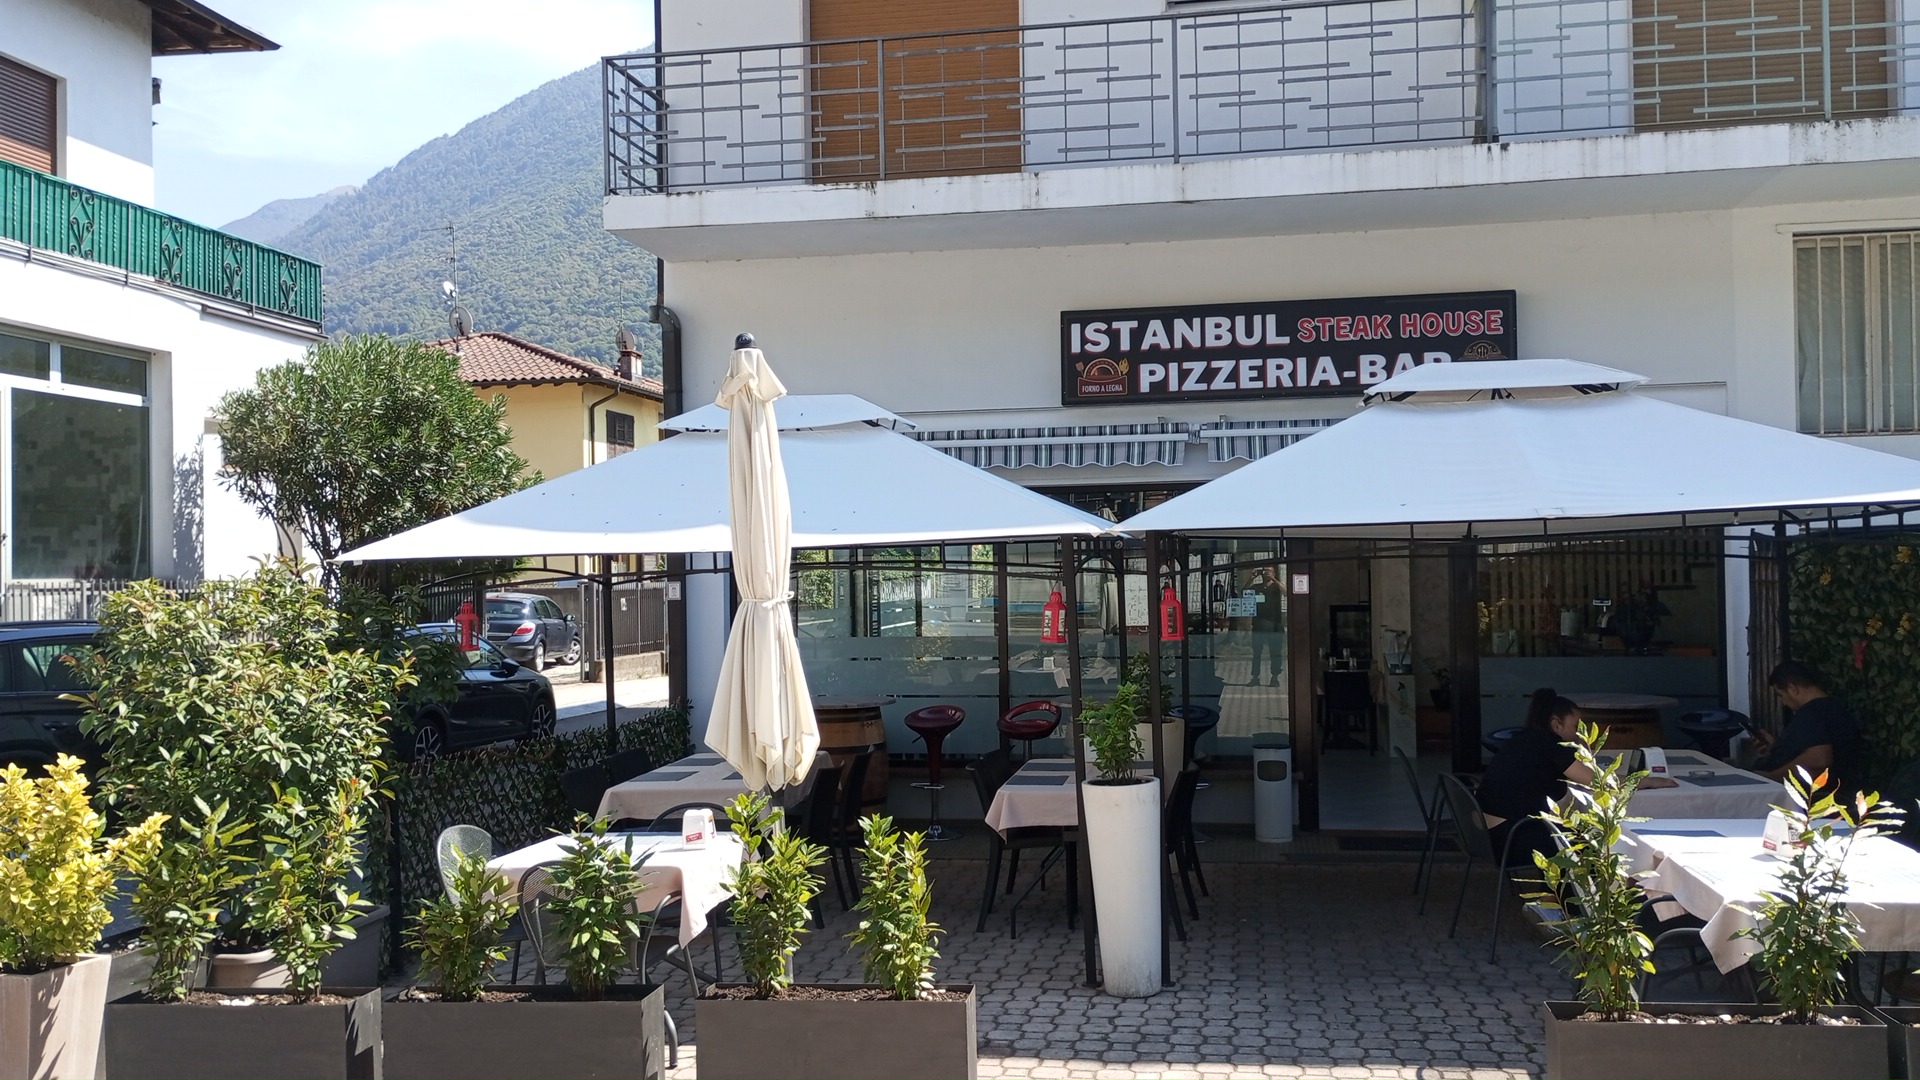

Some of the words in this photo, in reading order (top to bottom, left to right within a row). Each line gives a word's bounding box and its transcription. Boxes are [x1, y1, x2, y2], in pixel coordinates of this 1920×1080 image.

[1070, 314, 1290, 353] ISTANBUL
[1297, 315, 1392, 343] STEAK
[1400, 310, 1503, 337] HOUSE
[1082, 385, 1100, 393] FORNO
[1106, 384, 1123, 392] LEGNA
